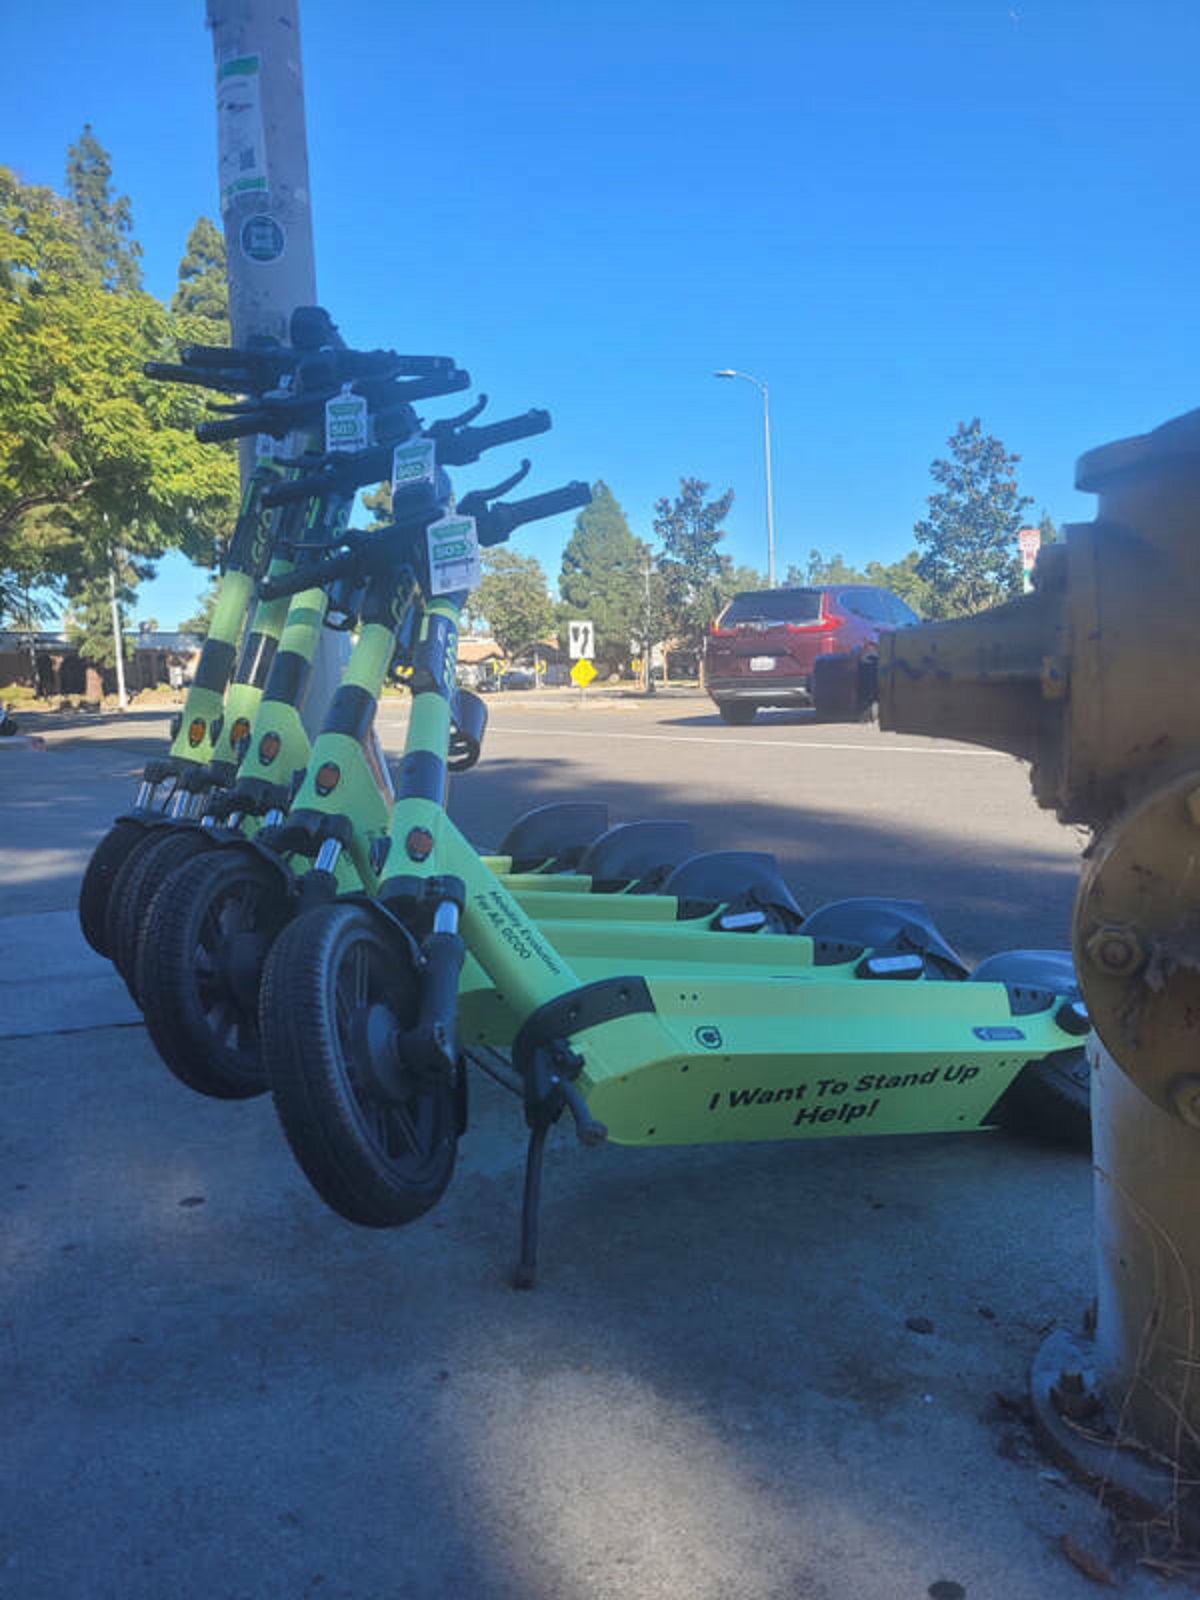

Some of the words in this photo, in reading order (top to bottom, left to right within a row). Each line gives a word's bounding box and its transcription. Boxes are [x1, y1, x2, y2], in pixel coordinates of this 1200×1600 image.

[708, 1092, 720, 1110] I
[729, 1081, 808, 1107] Want
[817, 1080, 849, 1097] To
[855, 1068, 939, 1092] Stand
[943, 1064, 979, 1083] Up
[793, 1099, 880, 1127] Help!
